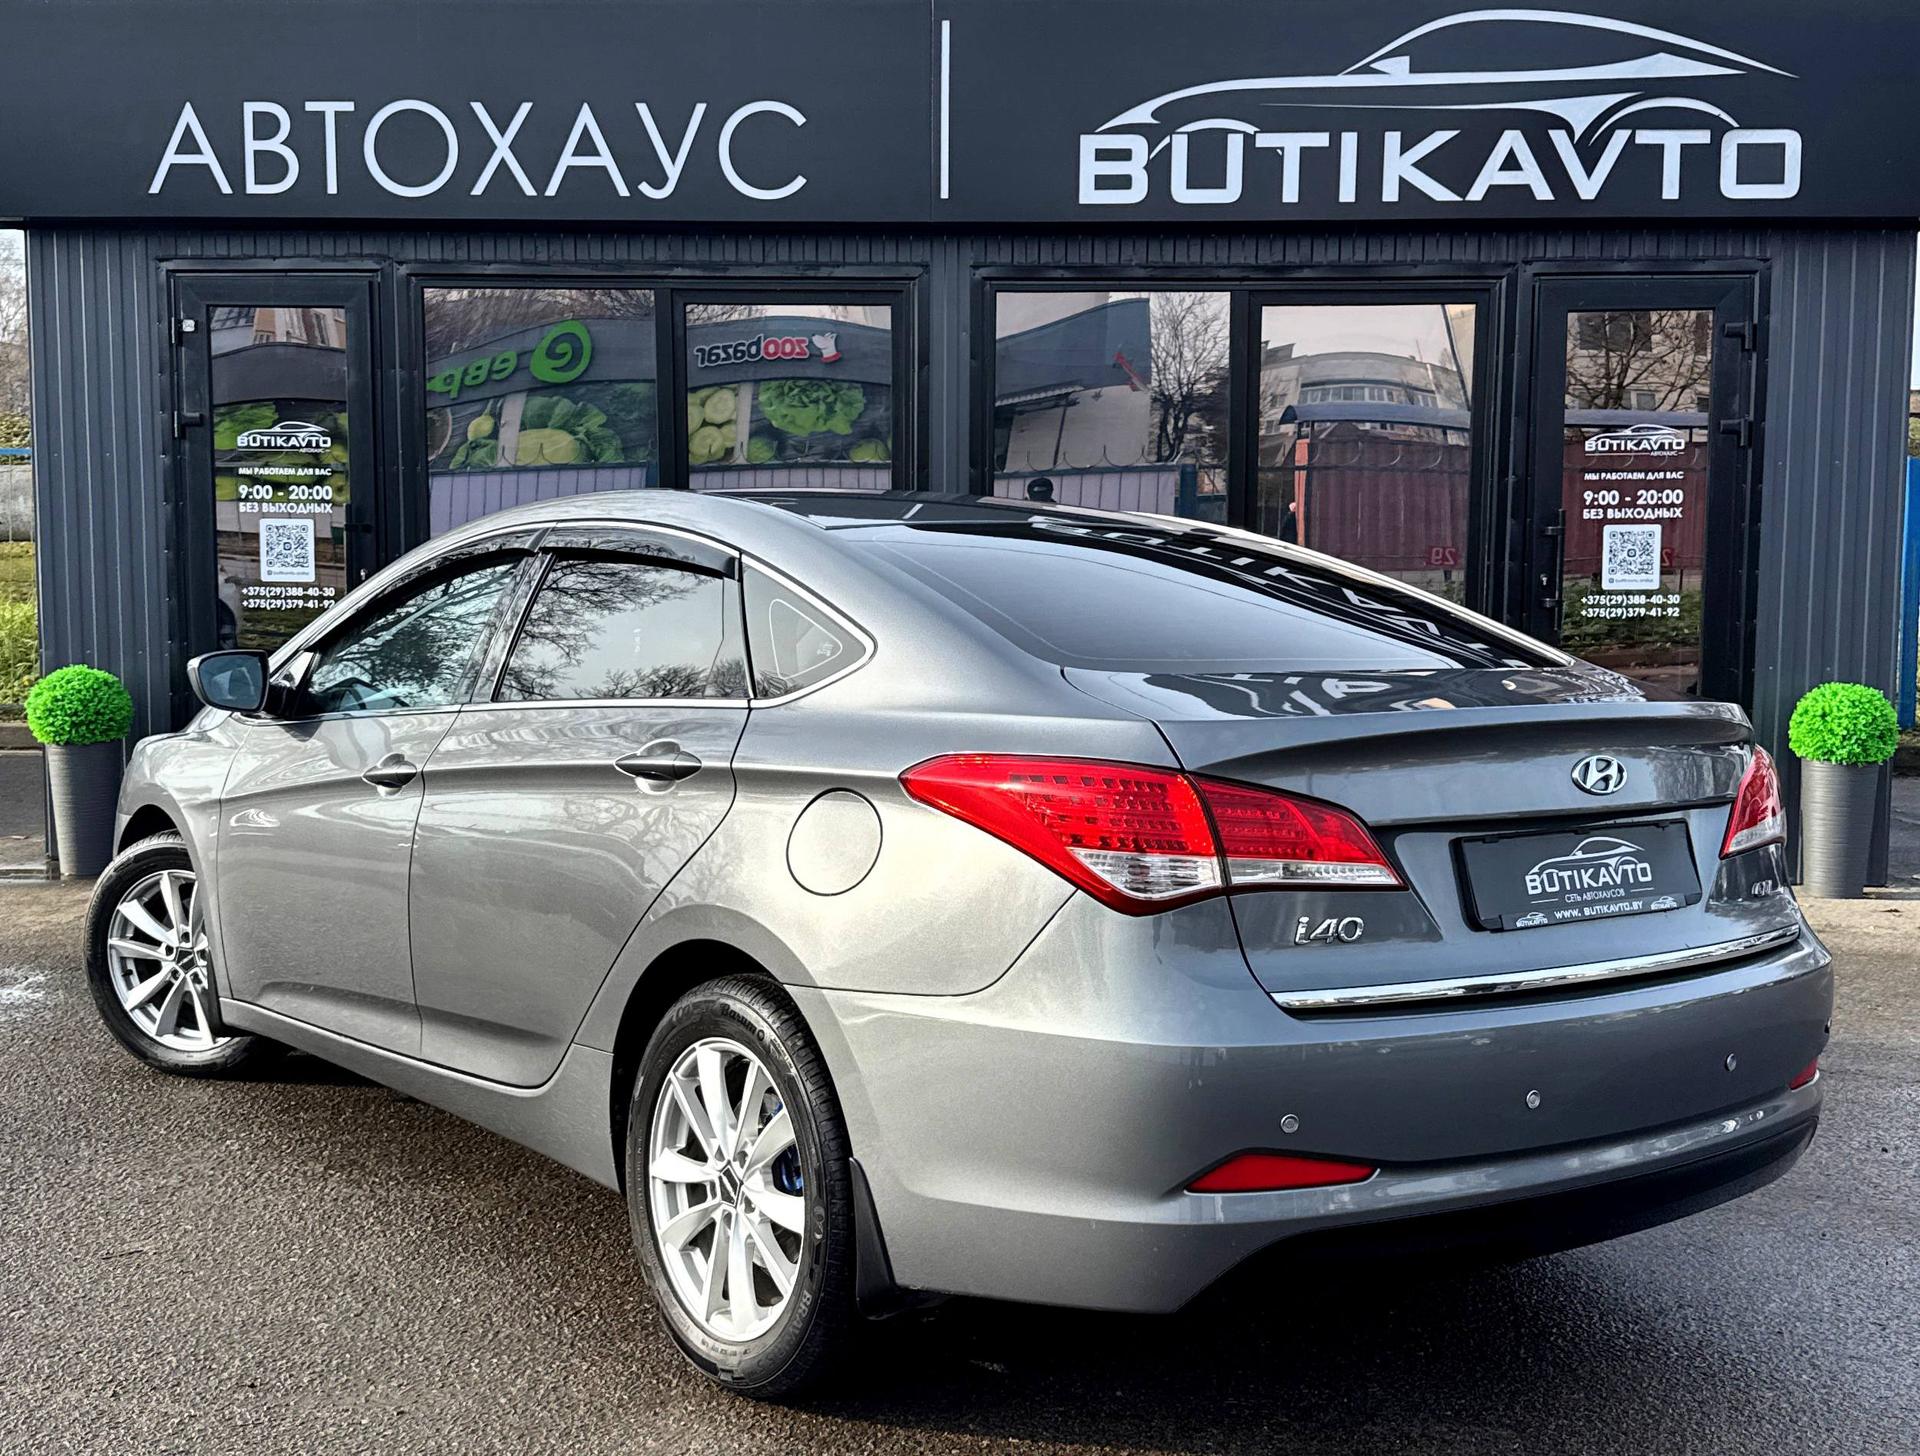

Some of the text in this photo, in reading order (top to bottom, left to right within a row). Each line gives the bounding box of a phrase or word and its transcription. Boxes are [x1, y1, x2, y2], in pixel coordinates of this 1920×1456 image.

[148, 99, 807, 200] АВТОХАУС
[1079, 127, 1802, 205] BUTIKAVTO
[237, 435, 332, 448] BUTIKAVTO
[1584, 439, 1686, 451] BUTIKAVTO
[238, 467, 332, 476] МЫ РАБОТАЕМ ДЛЯ ВАС
[1584, 471, 1684, 481] МЫ РАБОТАЕМ ДЛЯ ВАС
[238, 484, 273, 500] 9:00
[288, 485, 333, 500] 20:00
[1583, 490, 1620, 506] 9:00
[1636, 489, 1684, 505] 20:00
[239, 502, 333, 514] БЕЗ ВЫХОДНЫХ
[1583, 507, 1683, 520] БЕЗ ВЫХОДНЫХ
[242, 586, 335, 598] +375(29)388-40-30
[242, 598, 335, 610] +375(29)379-41-92
[1580, 594, 1680, 606] +375(29)388-40-30
[1580, 607, 1680, 619] +375(29)379-41-92
[1525, 862, 1653, 896] BUTIKAVTO
[1582, 887, 1626, 901] АВТОХАУСОВ
[1583, 900, 1643, 916] BUTIKAVTO.BY
[1294, 916, 1364, 944] i40
